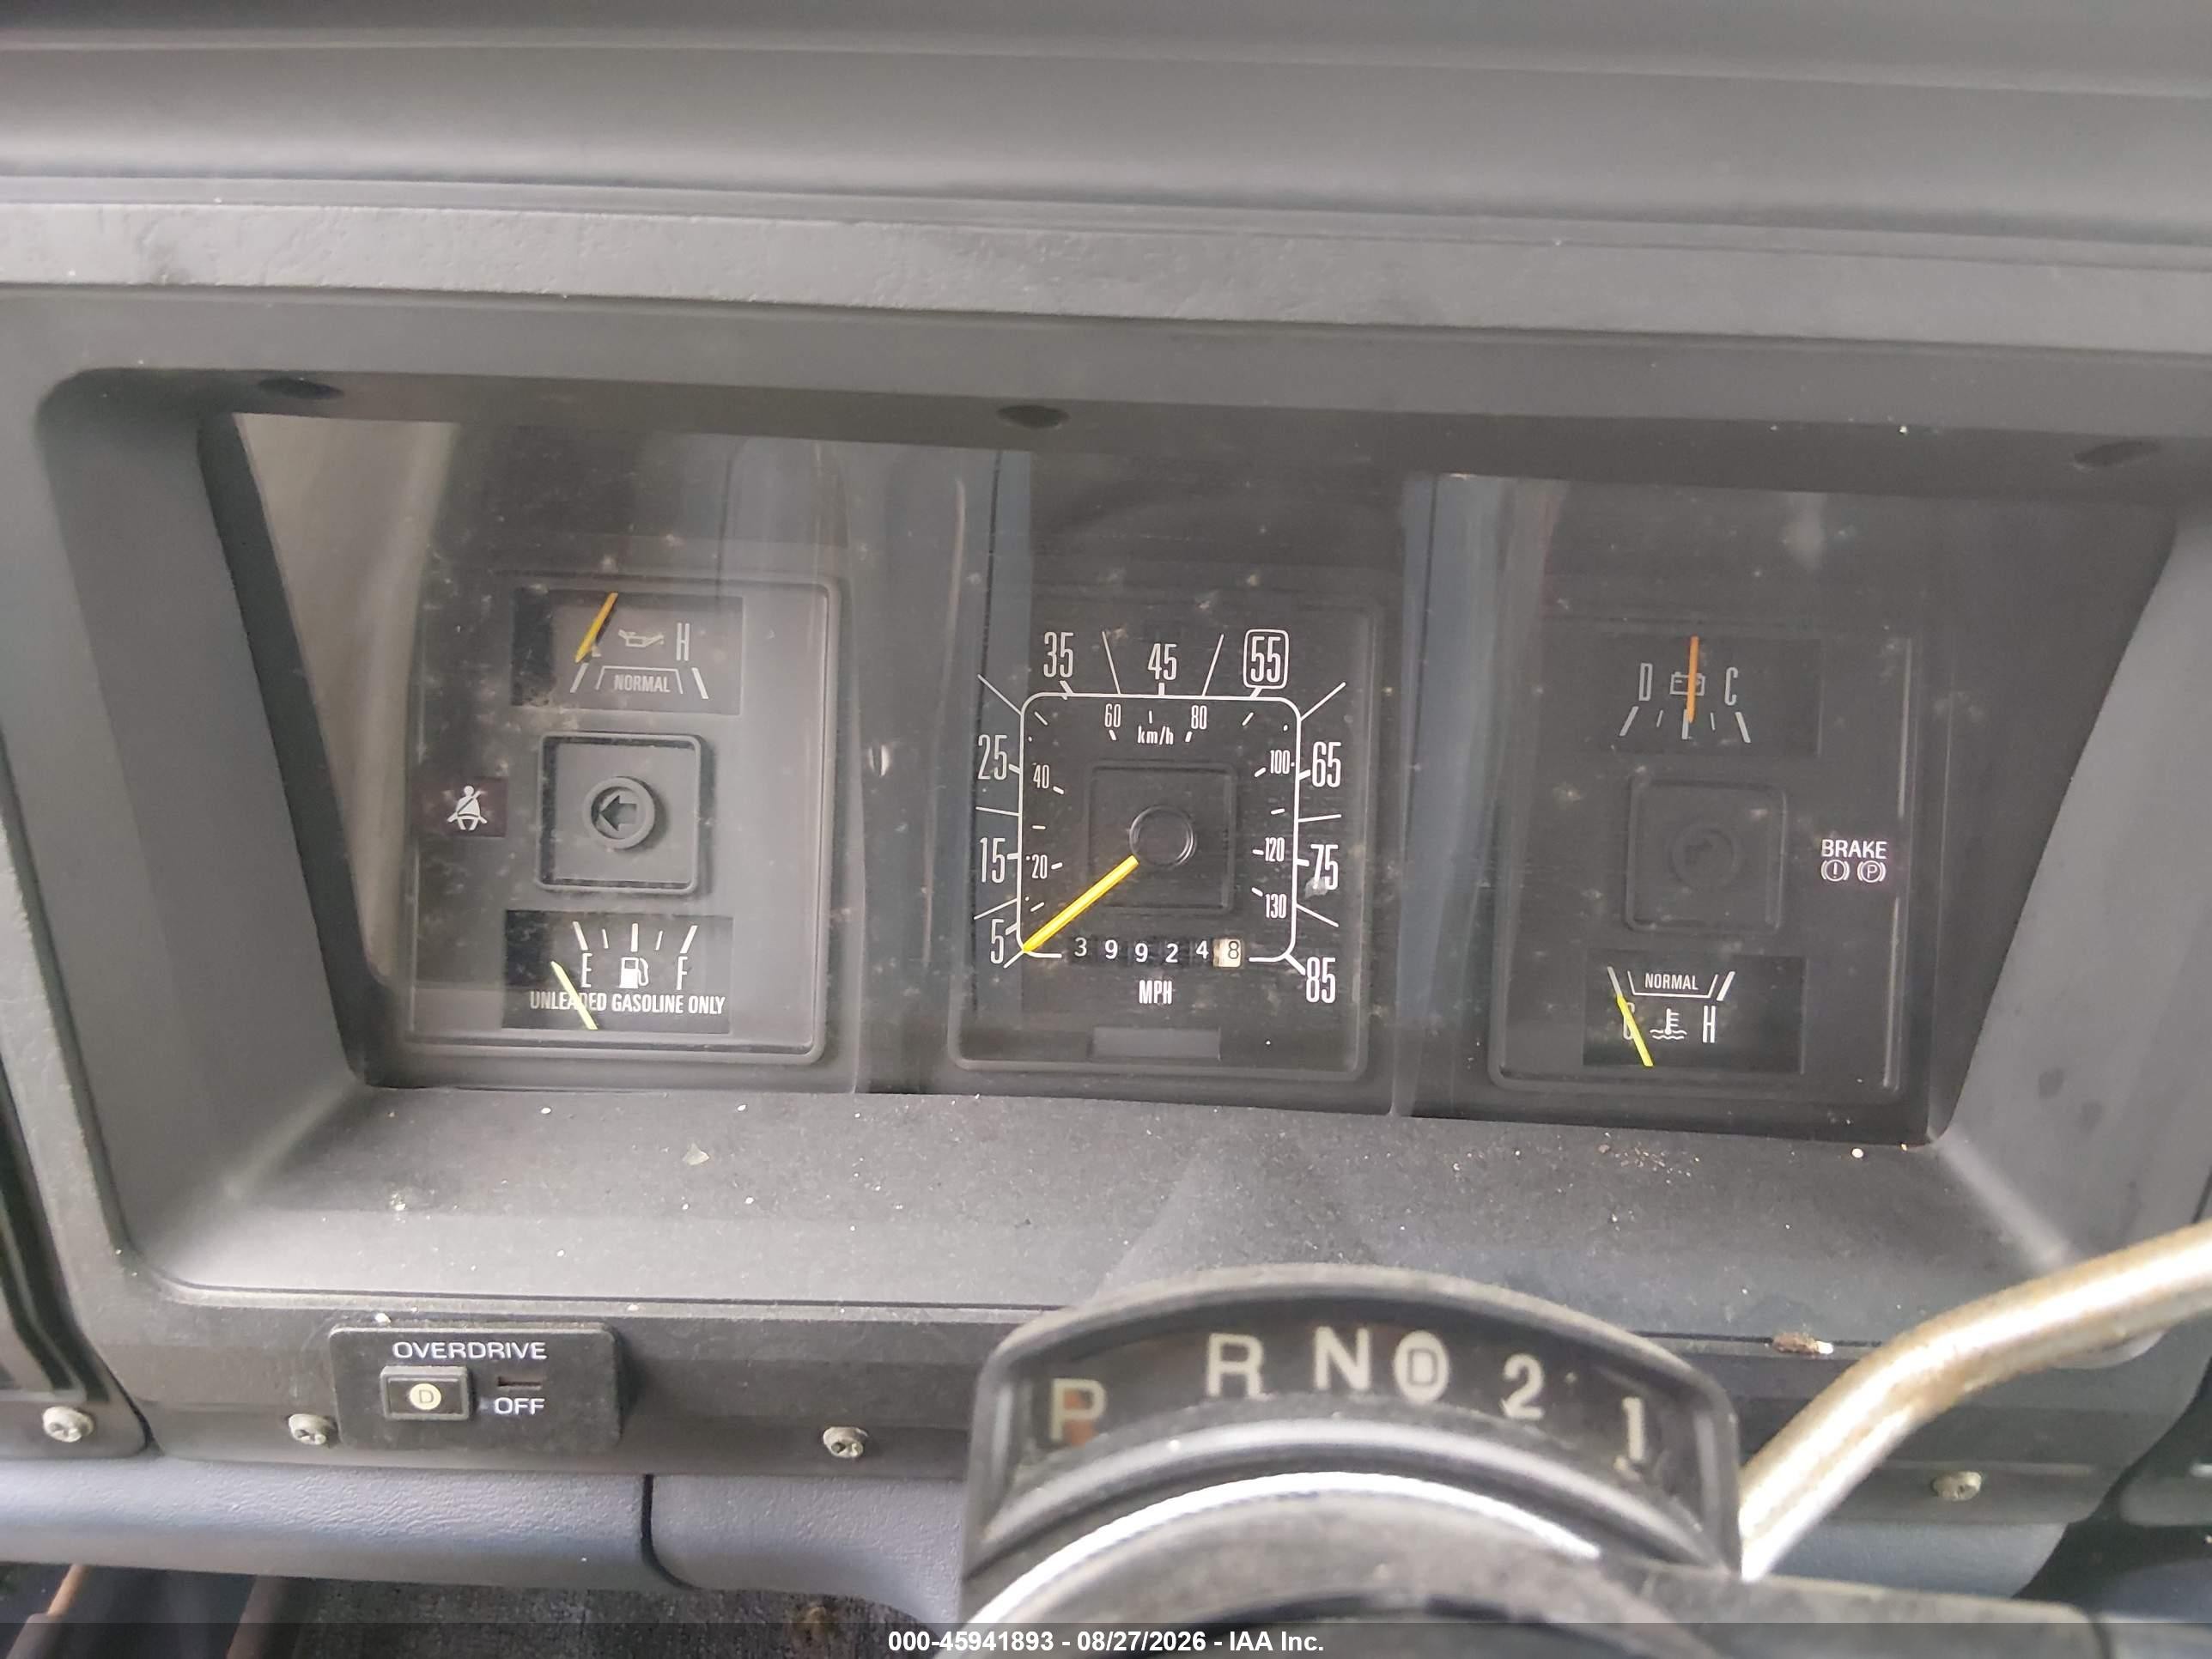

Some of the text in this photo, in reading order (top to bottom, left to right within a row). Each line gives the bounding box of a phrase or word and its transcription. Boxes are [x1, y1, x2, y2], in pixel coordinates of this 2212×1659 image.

[676, 622, 690, 661] H
[1042, 632, 1074, 678] 35
[1147, 643, 1177, 680] 45
[1249, 635, 1281, 683] 55
[613, 674, 672, 693] NORMAL
[1638, 662, 1653, 702] D
[1724, 666, 1739, 706] C
[1104, 703, 1121, 728] 60
[1191, 705, 1207, 730] 80
[1137, 725, 1175, 745] km/h
[978, 734, 1008, 781] 25
[1270, 750, 1291, 775] 100
[1312, 742, 1342, 787] 65
[1033, 764, 1050, 789] 40
[980, 838, 1006, 883] 15
[1264, 837, 1285, 862] 120
[1821, 839, 1887, 859] BRAKE
[1031, 854, 1048, 879] 20
[1310, 844, 1339, 890] 75
[1265, 893, 1287, 919] 130
[990, 919, 1005, 964] 5
[581, 953, 592, 988] E
[677, 956, 688, 990] F
[1306, 957, 1336, 1004] 85
[1644, 973, 1698, 990] NORMAL
[611, 994, 684, 1014] GASOLINE
[689, 996, 726, 1015] ONLY
[1139, 980, 1172, 1004] MPH
[1702, 1005, 1716, 1043] H
[392, 1341, 547, 1360] OVERDRIVE
[494, 1397, 545, 1414] OFF
[1050, 1377, 1106, 1442] P
[1206, 1333, 1263, 1396] R
[1314, 1326, 1370, 1390] N
[1501, 1353, 1544, 1419] 2
[1622, 1396, 1644, 1460] 1
